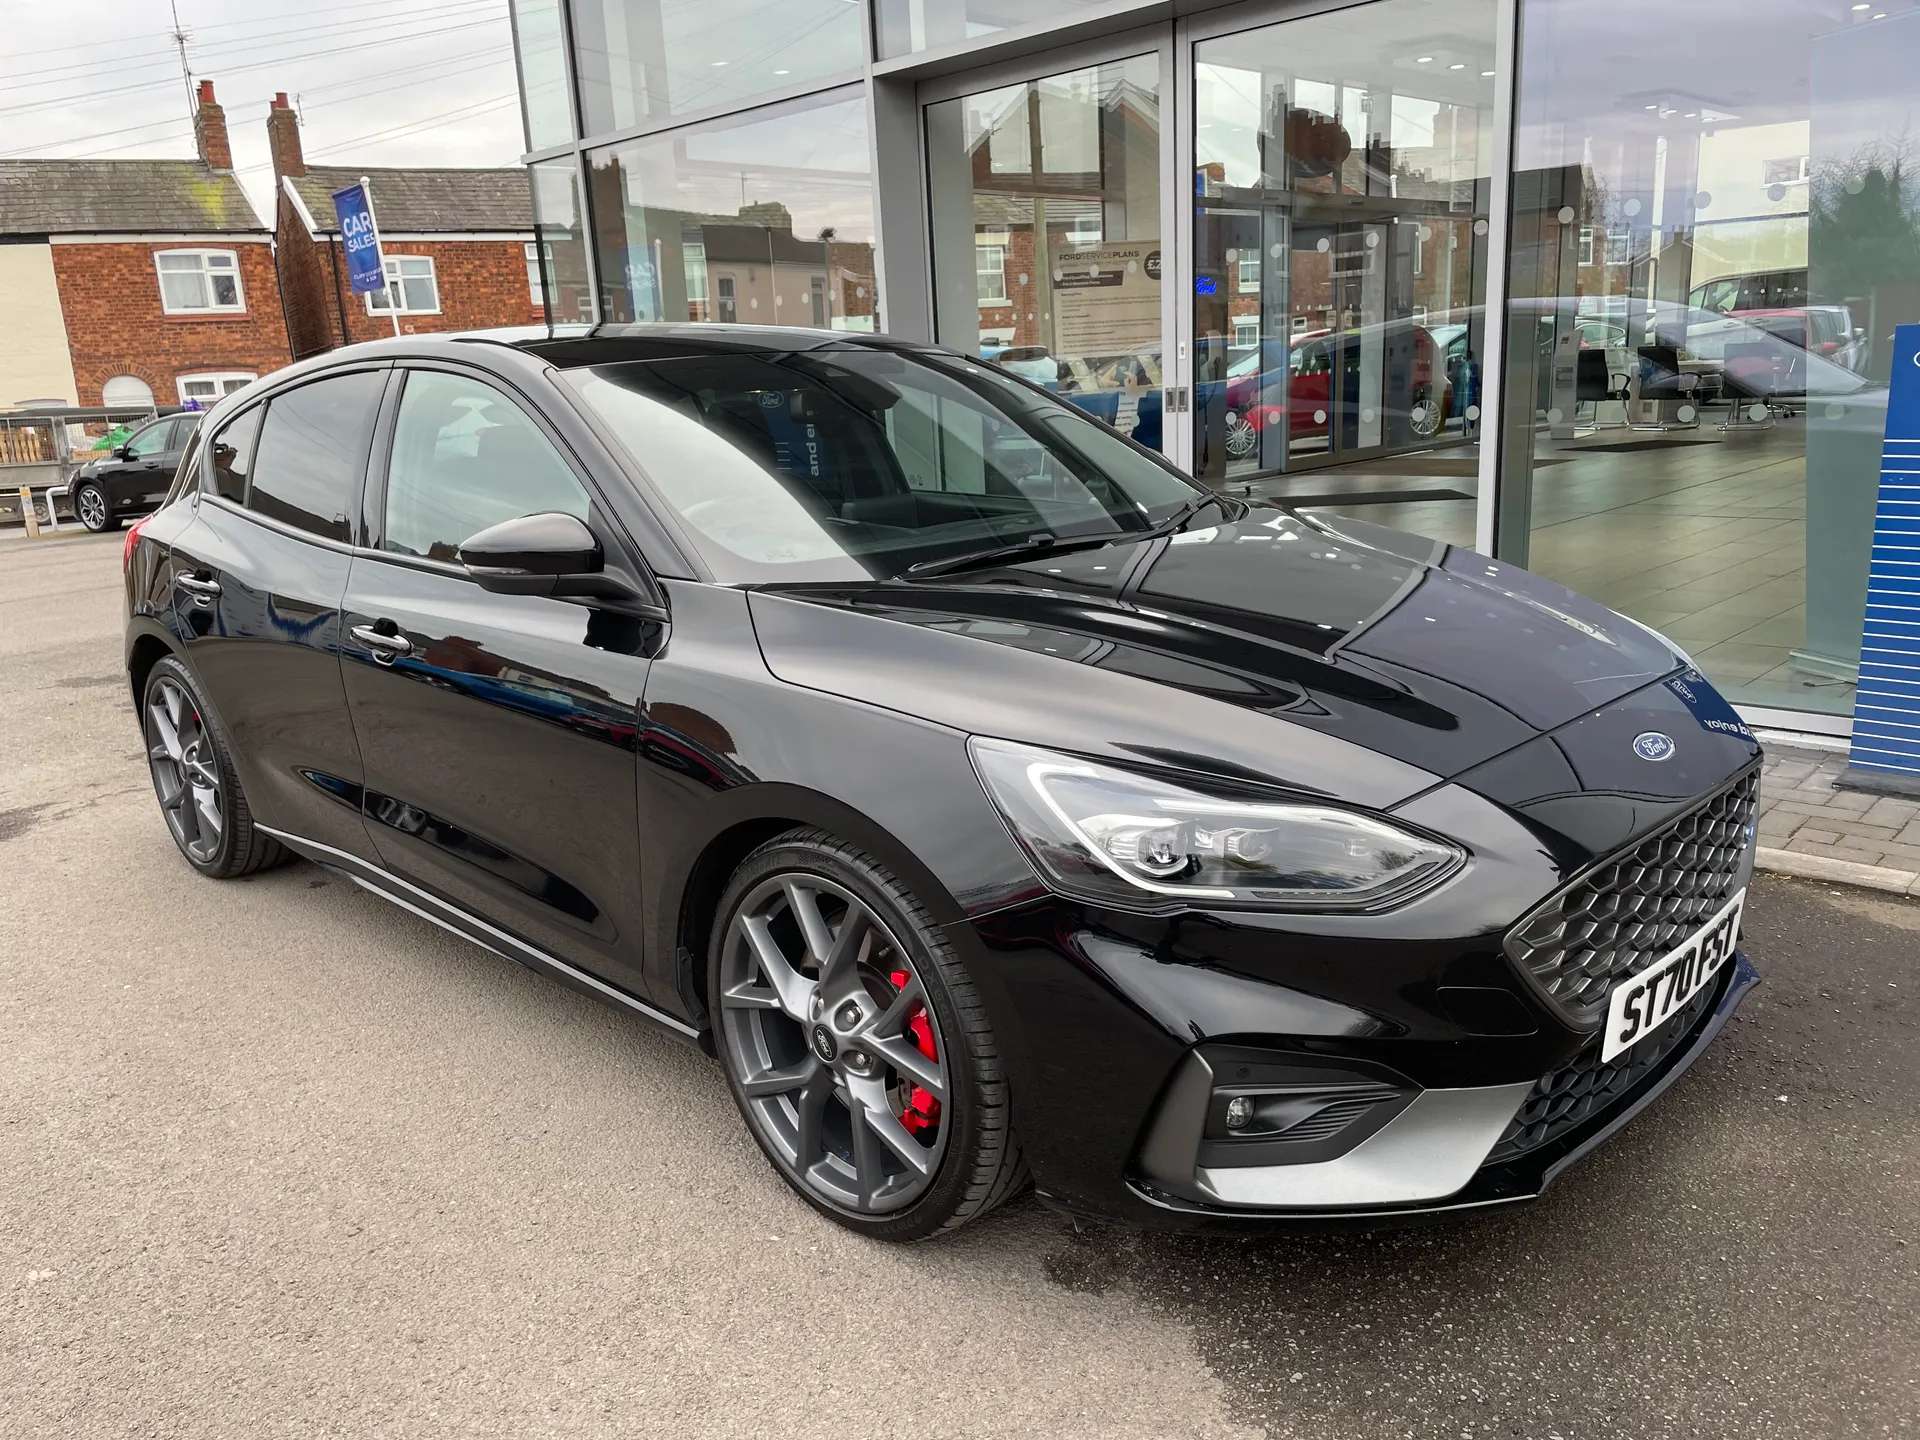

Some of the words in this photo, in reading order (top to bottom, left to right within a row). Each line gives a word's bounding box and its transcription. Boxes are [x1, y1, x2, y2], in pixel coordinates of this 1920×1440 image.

[343, 211, 372, 238] CAR
[348, 232, 376, 253] SALES
[806, 442, 819, 477] and
[1620, 946, 1697, 1043] ST70
[1694, 903, 1740, 987] FST
